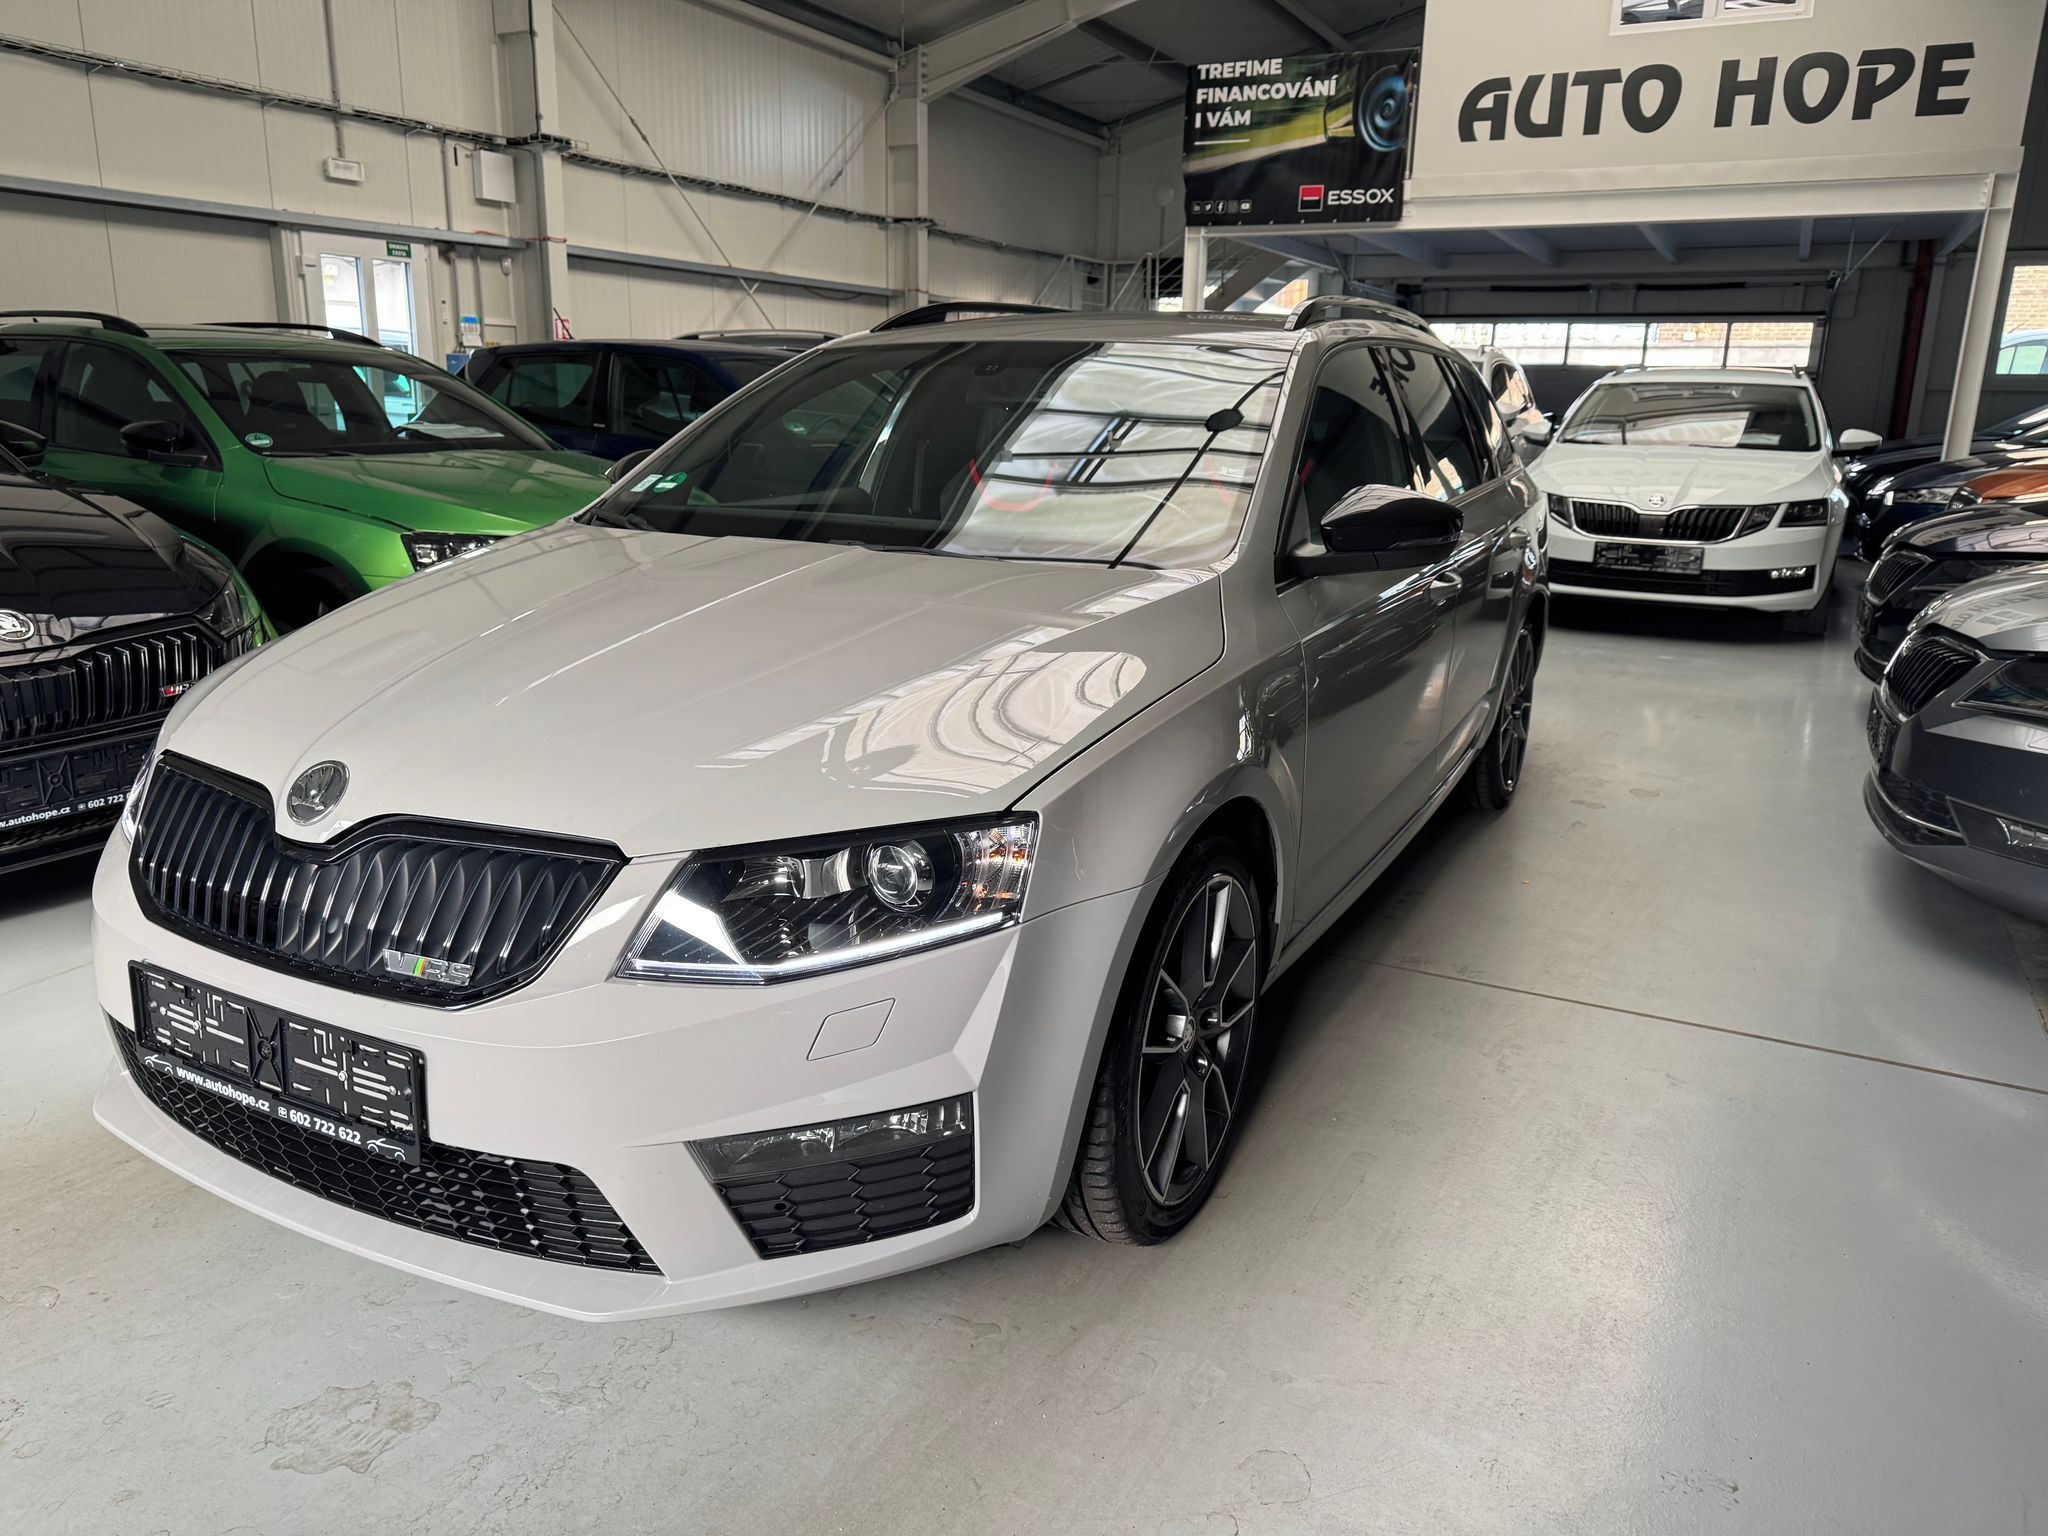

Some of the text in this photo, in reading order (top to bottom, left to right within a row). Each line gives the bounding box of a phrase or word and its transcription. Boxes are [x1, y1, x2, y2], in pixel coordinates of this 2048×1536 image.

[1197, 58, 1283, 80] TREFIME
[1195, 75, 1338, 105] FINANCOVÁNÍ
[1457, 41, 1975, 143] AUTO HOPE
[1194, 106, 1251, 129] I VÁM
[1327, 187, 1395, 206] ESSOX
[87, 798, 106, 809] 602
[107, 794, 125, 805] 722
[176, 1065, 362, 1145] www.autohope.cz 602 722 622
